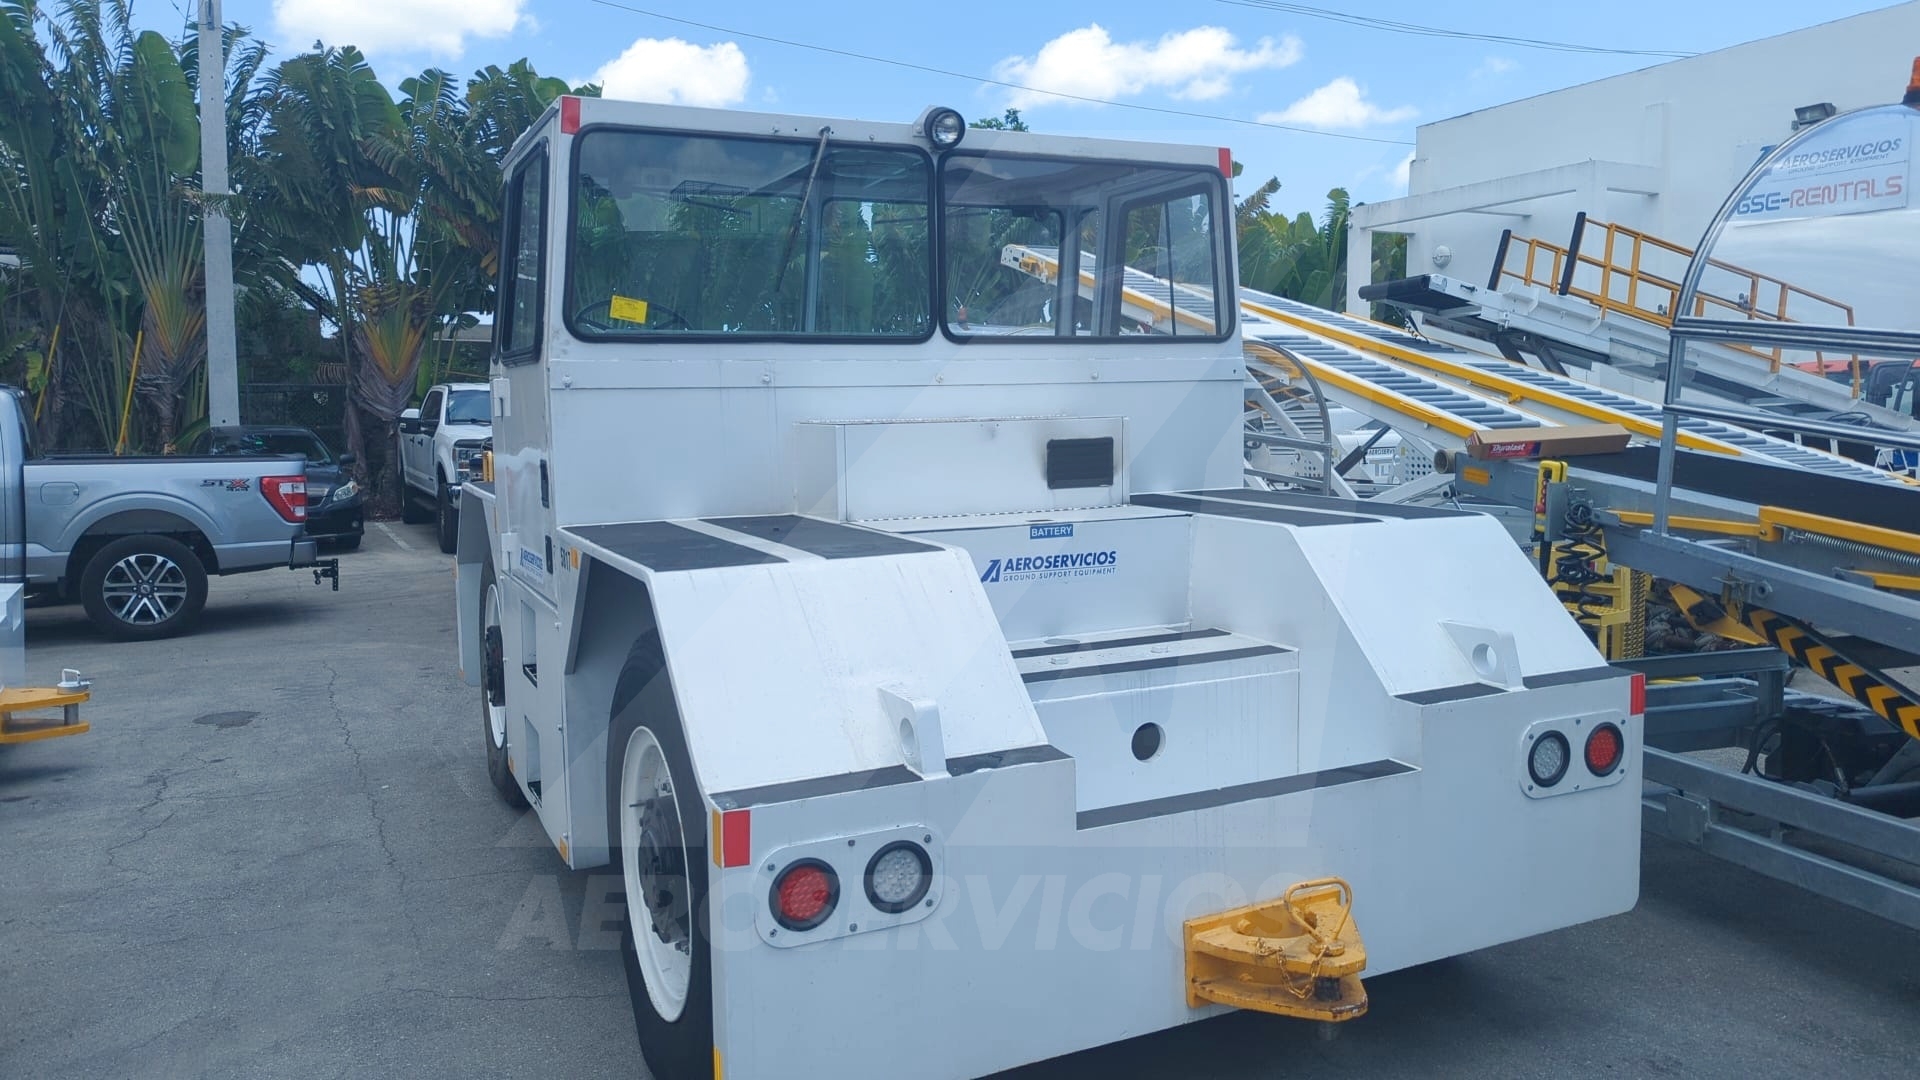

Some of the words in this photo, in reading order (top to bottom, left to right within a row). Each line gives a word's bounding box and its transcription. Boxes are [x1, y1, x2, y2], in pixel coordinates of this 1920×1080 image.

[1780, 138, 1902, 169] AEROSERVICIOS
[1031, 526, 1072, 537] BATTERY
[1003, 551, 1117, 572] AEROSERVICIOS
[1003, 573, 1036, 582] GROUND
[1039, 570, 1071, 579] SUPPORT
[1074, 567, 1116, 576] EQUIPMENT
